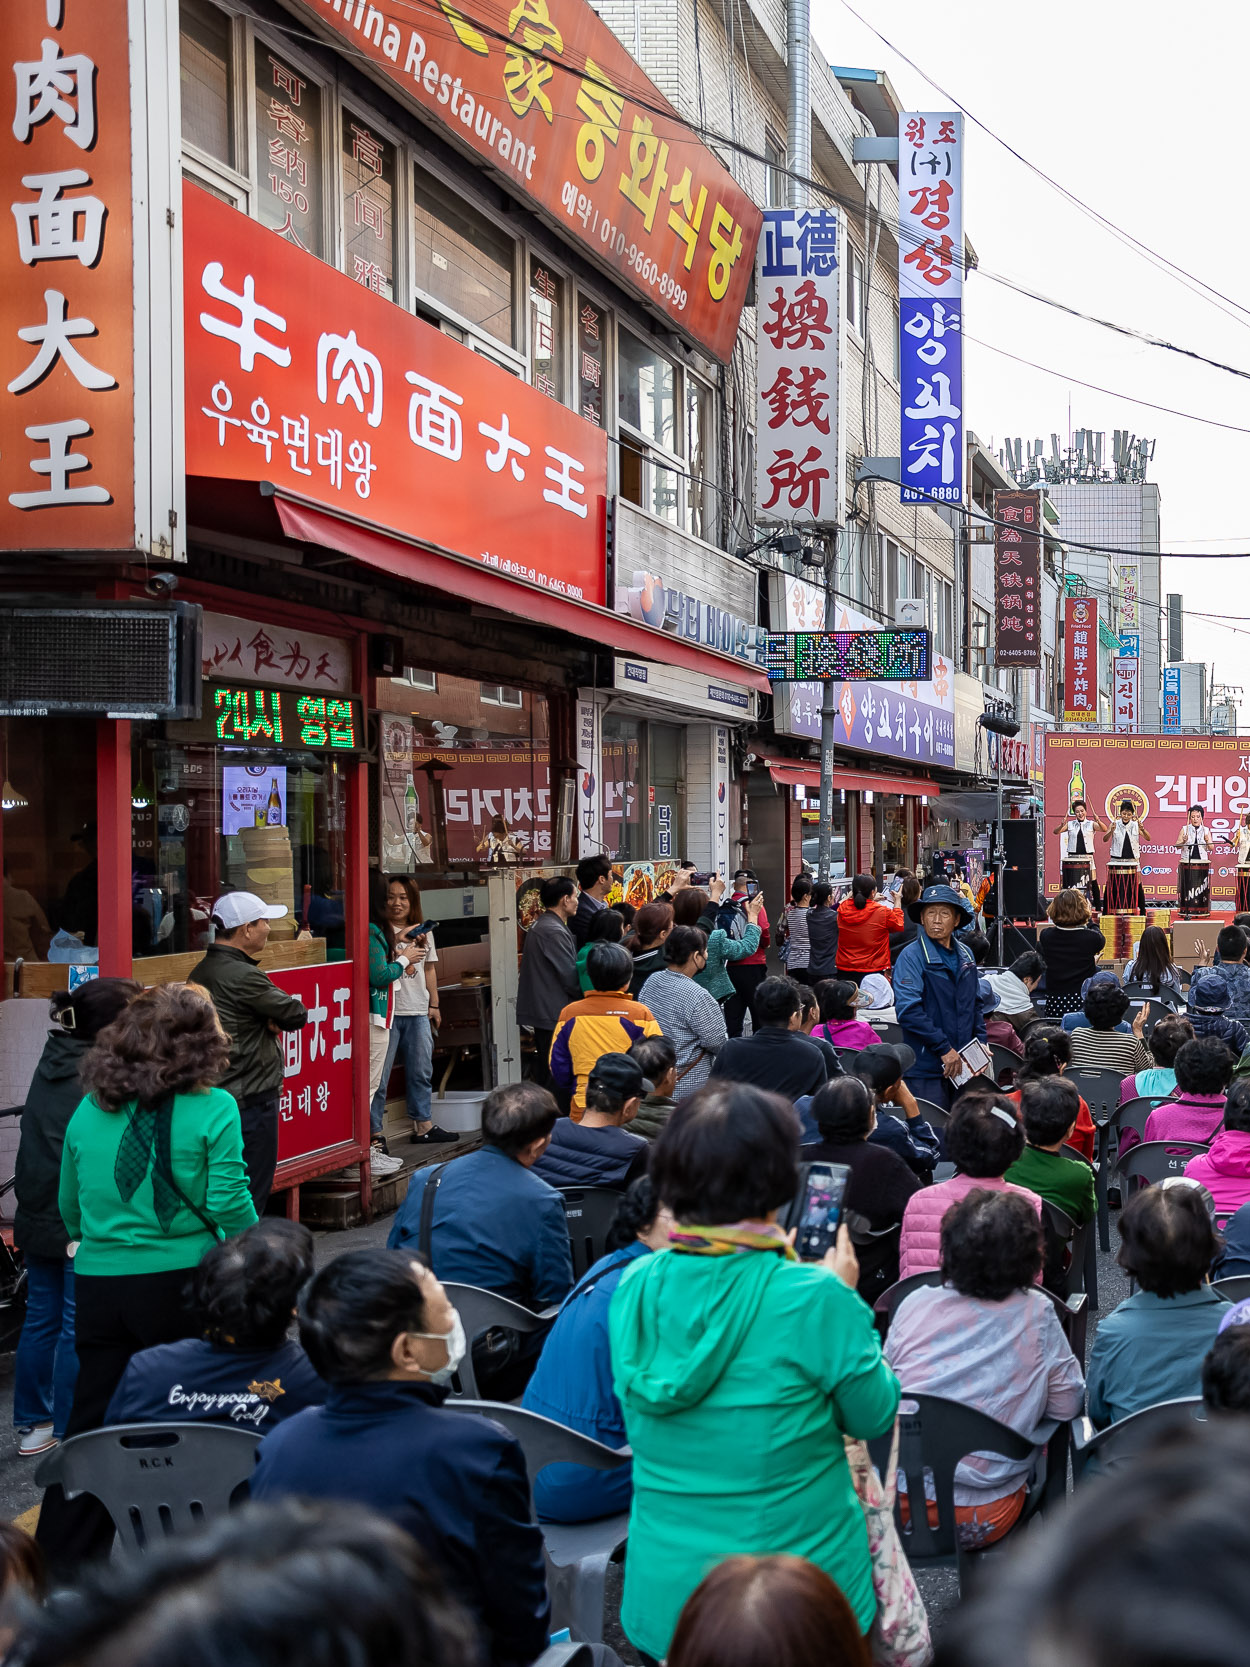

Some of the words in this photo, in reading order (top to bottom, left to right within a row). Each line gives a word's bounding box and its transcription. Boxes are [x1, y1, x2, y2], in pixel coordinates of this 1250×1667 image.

[323, 0, 402, 63] ina
[404, 31, 537, 181] Restaurant
[904, 117, 957, 149] 원조
[576, 56, 743, 301] 중화식당
[561, 181, 593, 229] 예약
[601, 218, 688, 311] 010-9660-8999
[762, 210, 839, 278] 正德
[904, 180, 956, 286] 경성
[200, 261, 588, 519] 牛肉面大王
[904, 301, 961, 485] 양꼬치
[201, 380, 377, 500] 우육면대왕
[203, 629, 338, 684] 以食为天
[1073, 630, 1089, 707] 趙胖子炸肉
[214, 689, 284, 743] 24시
[296, 696, 356, 748] 영업
[861, 687, 933, 757] 양꼬치구이
[168, 1383, 217, 1411] Enjoy
[217, 1393, 261, 1409] your
[230, 1403, 269, 1426] Golf
